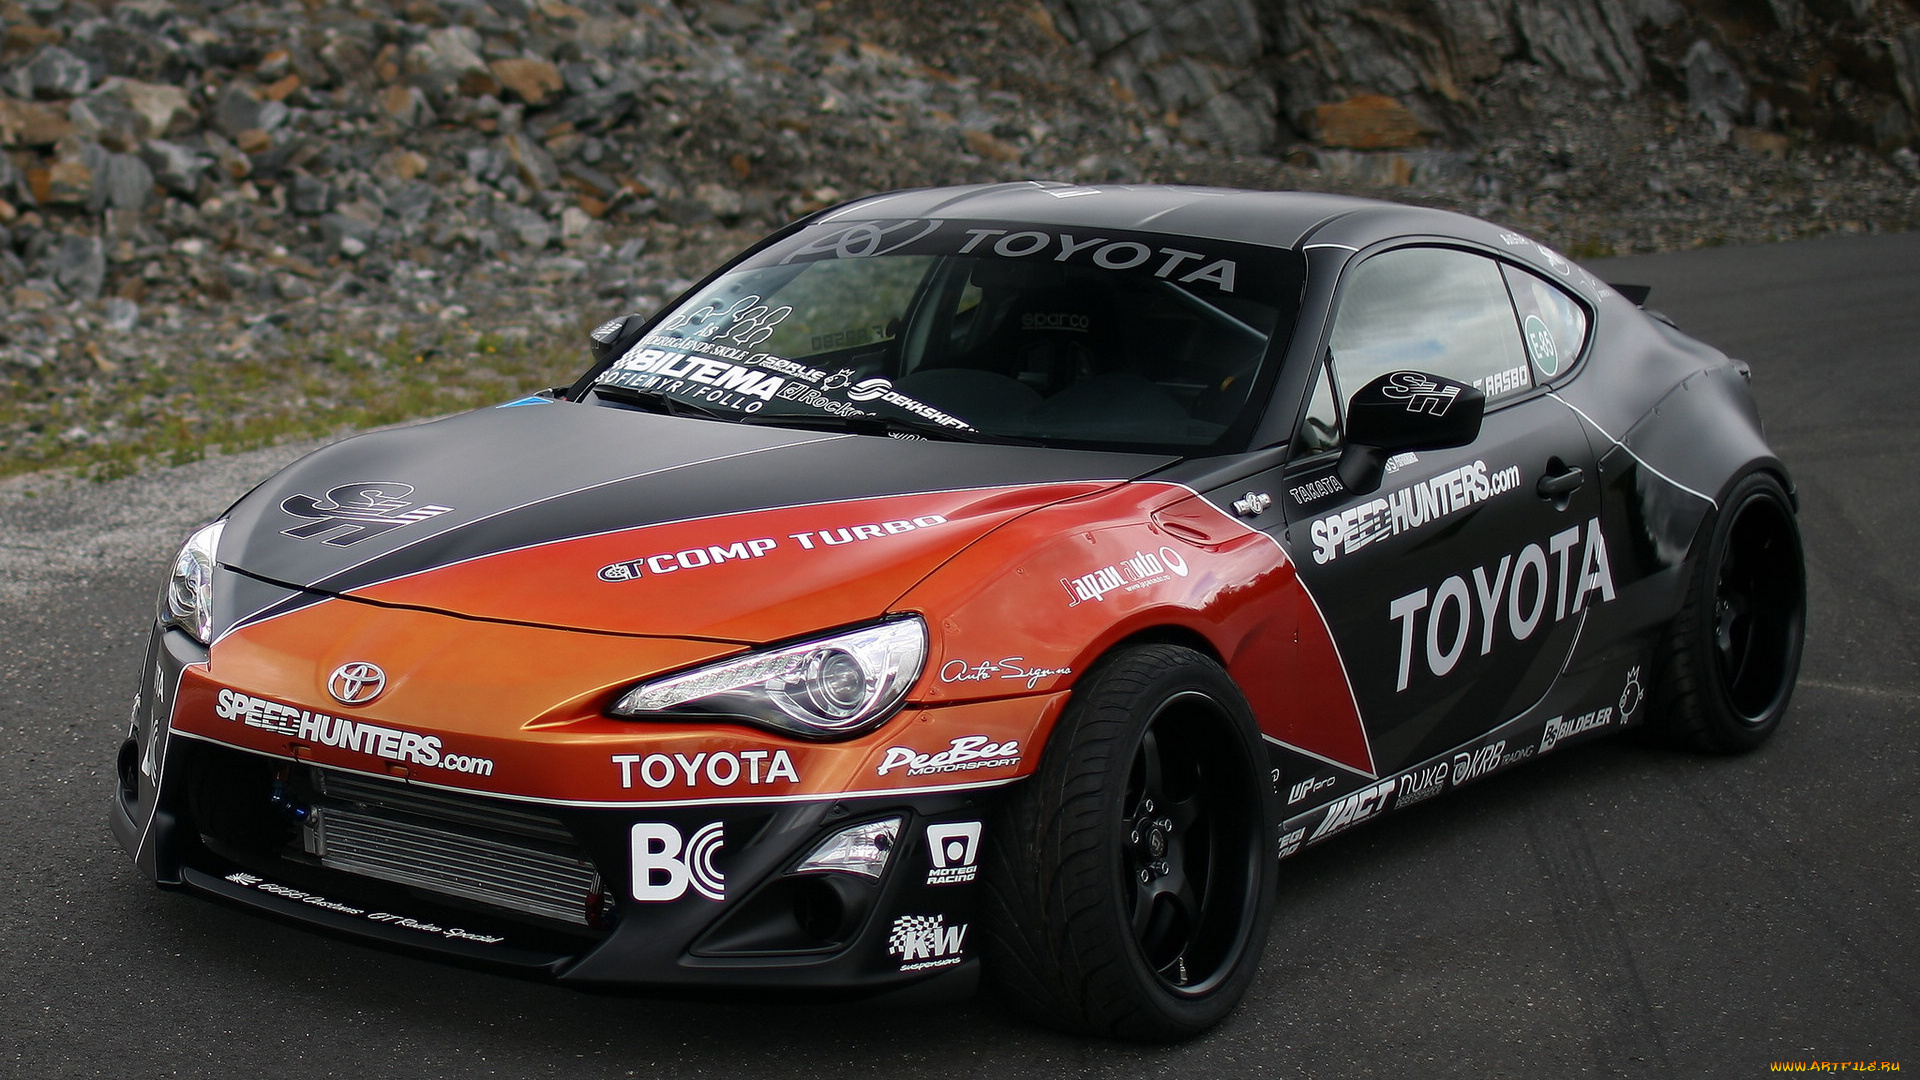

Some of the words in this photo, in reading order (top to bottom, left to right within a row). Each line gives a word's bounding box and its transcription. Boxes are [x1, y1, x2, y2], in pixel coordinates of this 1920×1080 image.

[958, 229, 1236, 292] TOYOTA
[1022, 312, 1089, 330] sparco
[624, 349, 785, 401] BILTEMA
[1289, 475, 1344, 505] TAKATA
[1311, 459, 1521, 565] SPEEDHUNTERS.com
[647, 538, 778, 575] COMP
[788, 514, 949, 550] TURBO
[1389, 516, 1616, 693] TOYOTA
[215, 688, 494, 777] SPEEDHUNTERS.com
[1557, 706, 1613, 740] BILDELER
[612, 750, 800, 788] TOYOTA
[907, 756, 1021, 777] MOTORSPORT
[1502, 745, 1534, 764] TRADING
[929, 865, 977, 876] MOTEGI
